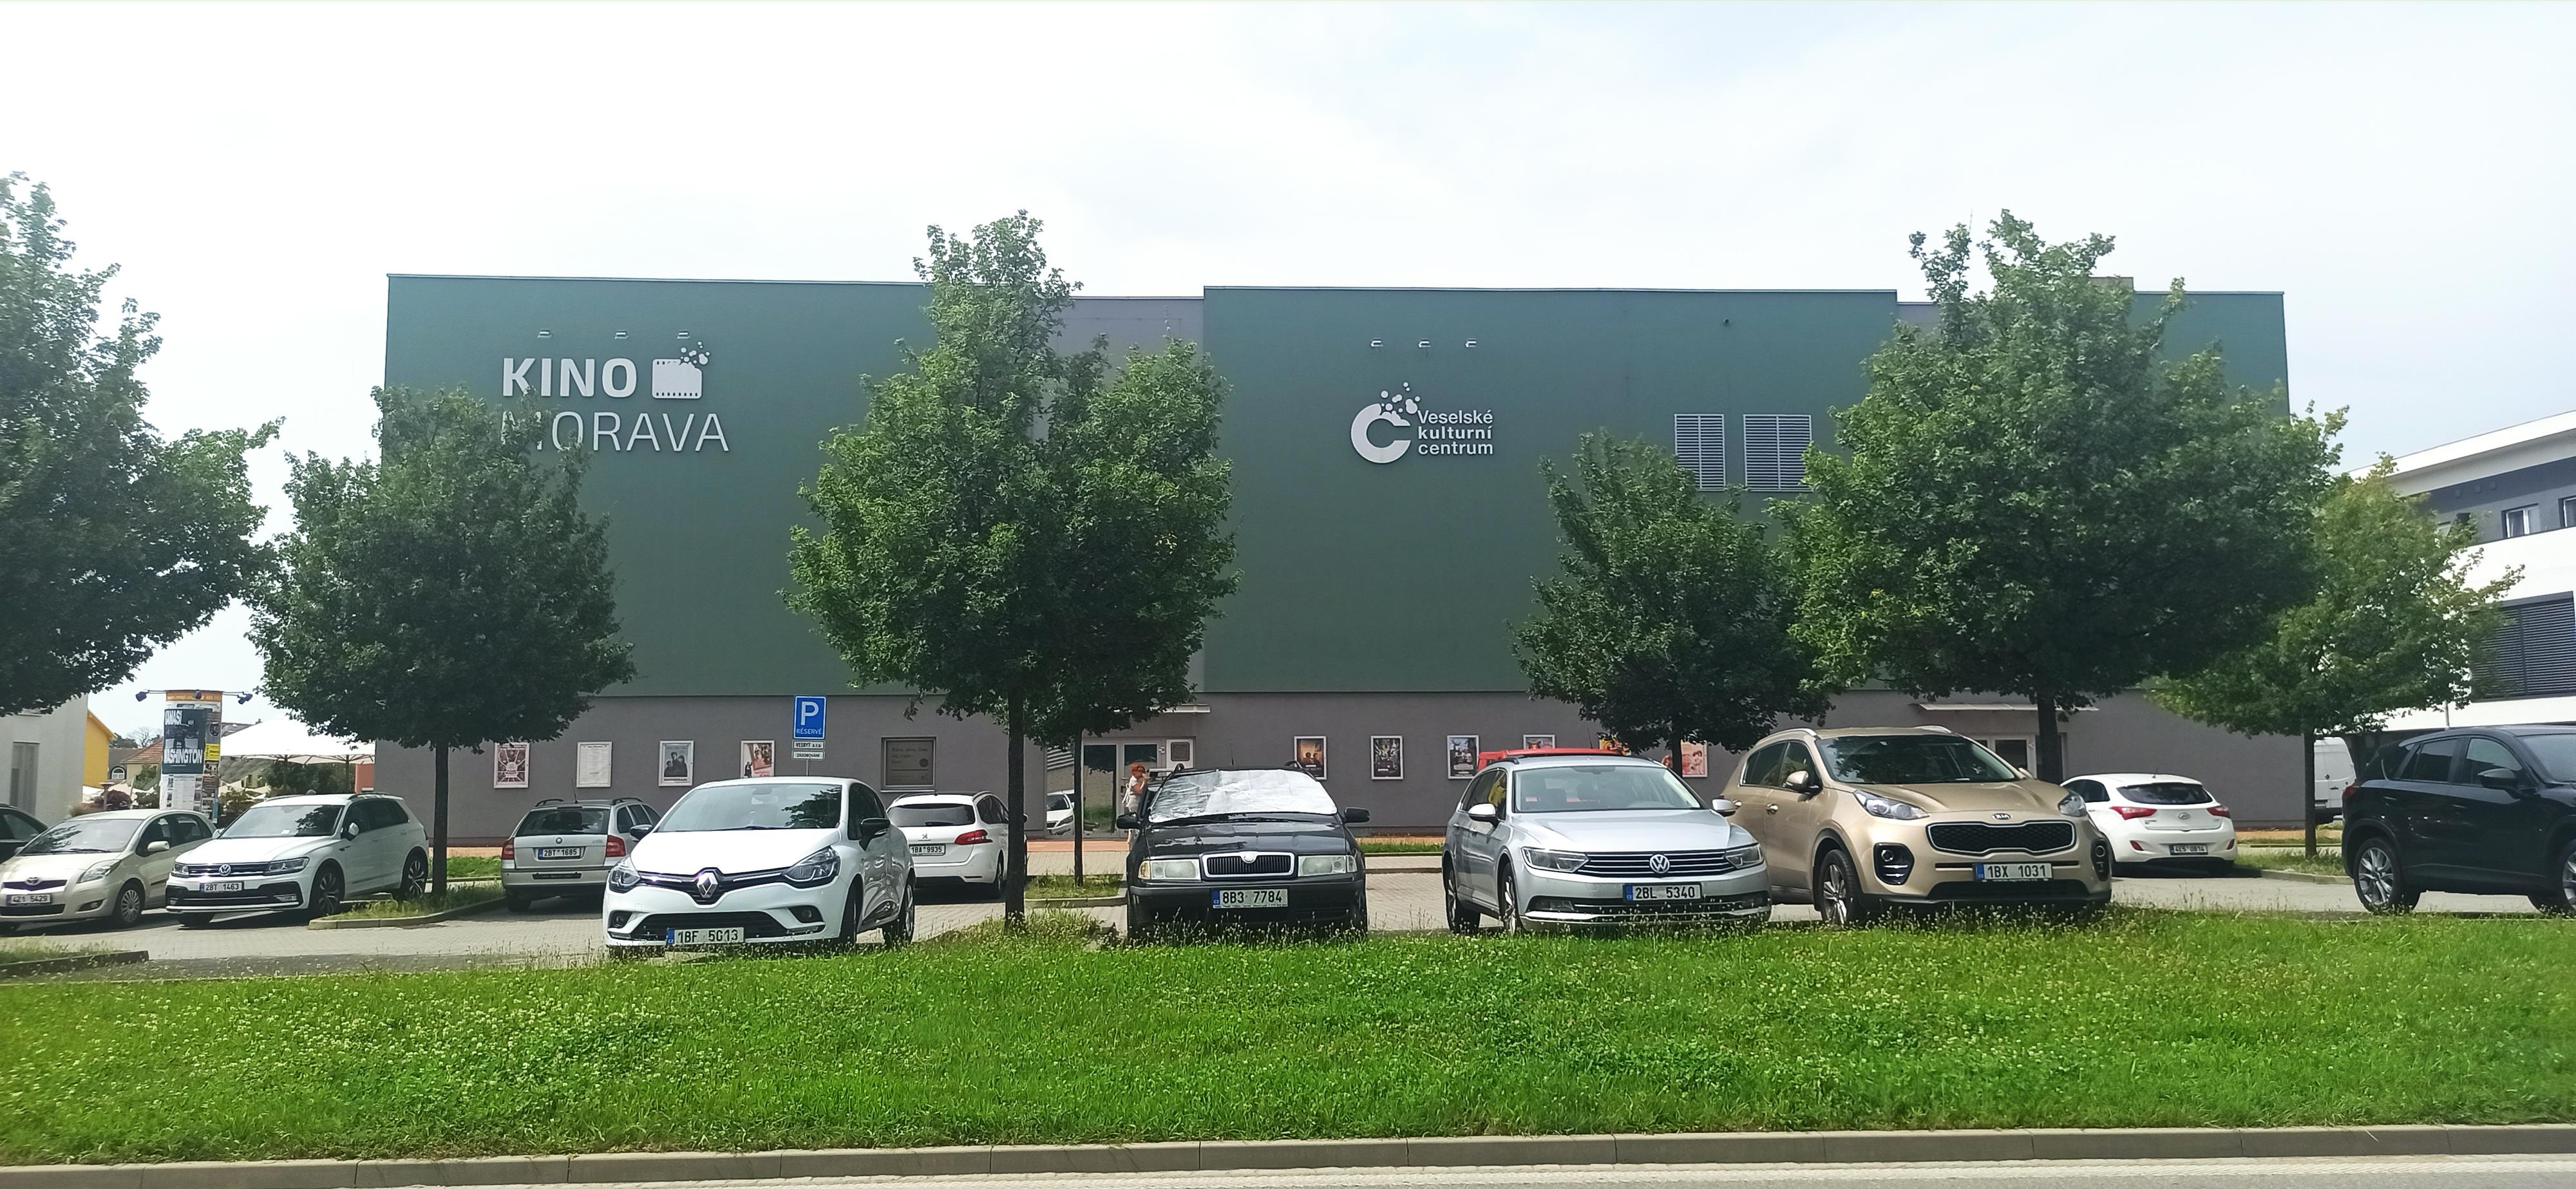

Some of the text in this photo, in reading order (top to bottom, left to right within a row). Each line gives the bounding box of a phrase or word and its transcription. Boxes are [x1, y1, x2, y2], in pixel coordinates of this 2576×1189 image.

[502, 357, 637, 398] KINO
[1417, 409, 1493, 424] Veselské
[1418, 426, 1493, 440] kulturní
[1418, 441, 1493, 455] centrum
[800, 701, 819, 726] P
[1987, 865, 2009, 878] 1BX
[2018, 865, 2045, 877] 1031
[1223, 892, 1244, 904] 8B3
[1253, 890, 1282, 903] 7784
[1635, 887, 1657, 899] 2BL
[1665, 886, 1695, 899] 5340
[677, 930, 699, 943] 1BF
